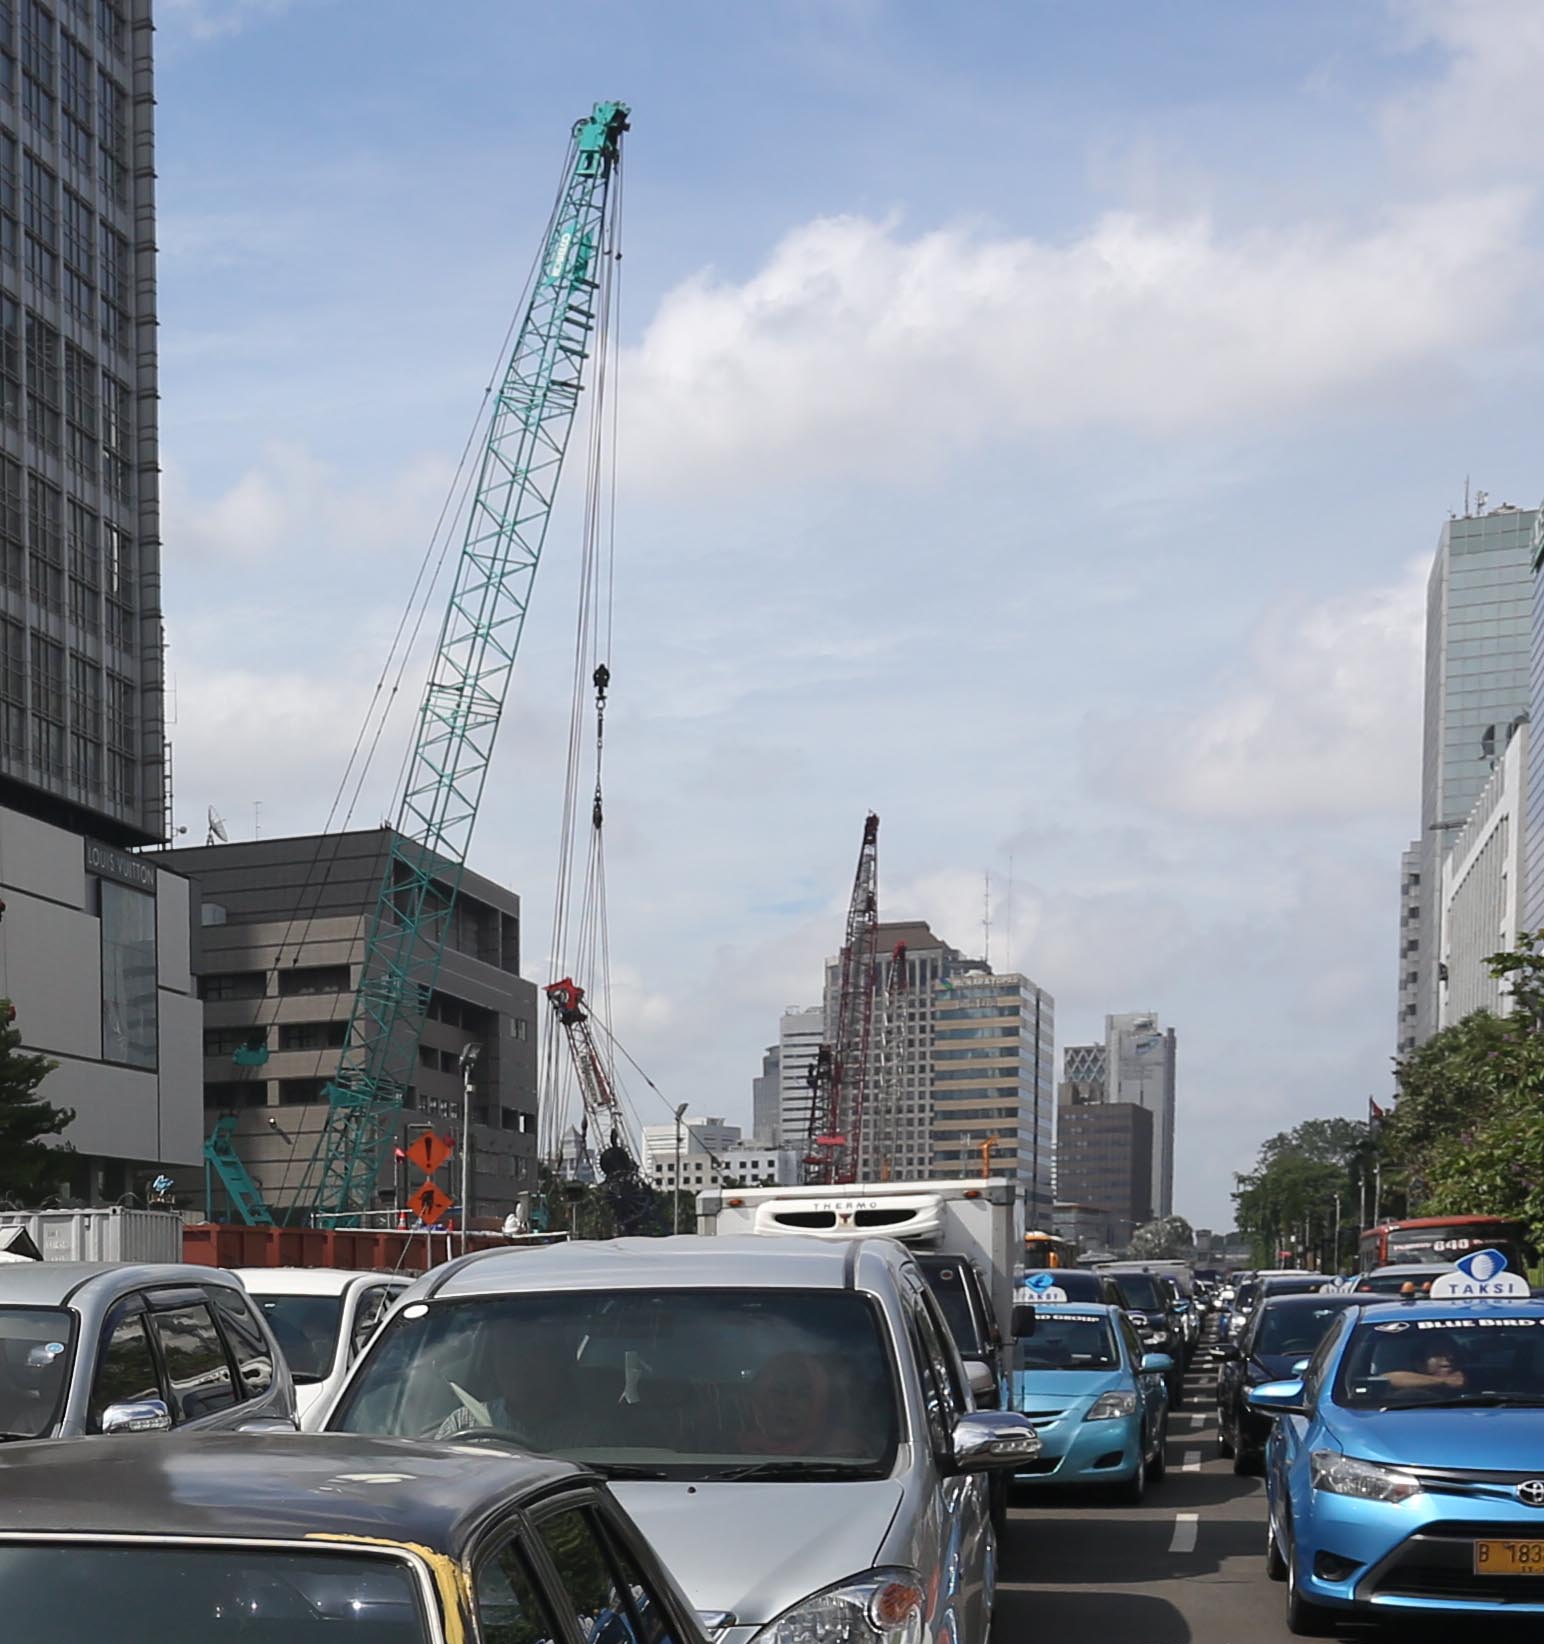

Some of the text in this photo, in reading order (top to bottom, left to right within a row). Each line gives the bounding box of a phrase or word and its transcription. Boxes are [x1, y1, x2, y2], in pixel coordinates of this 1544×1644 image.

[814, 1201, 877, 1211] THERMO
[1449, 1283, 1514, 1294] TAKSI
[1417, 1320, 1476, 1330] BLUE
[1478, 1318, 1537, 1327] BIRD
[1479, 1543, 1544, 1563] B 183
